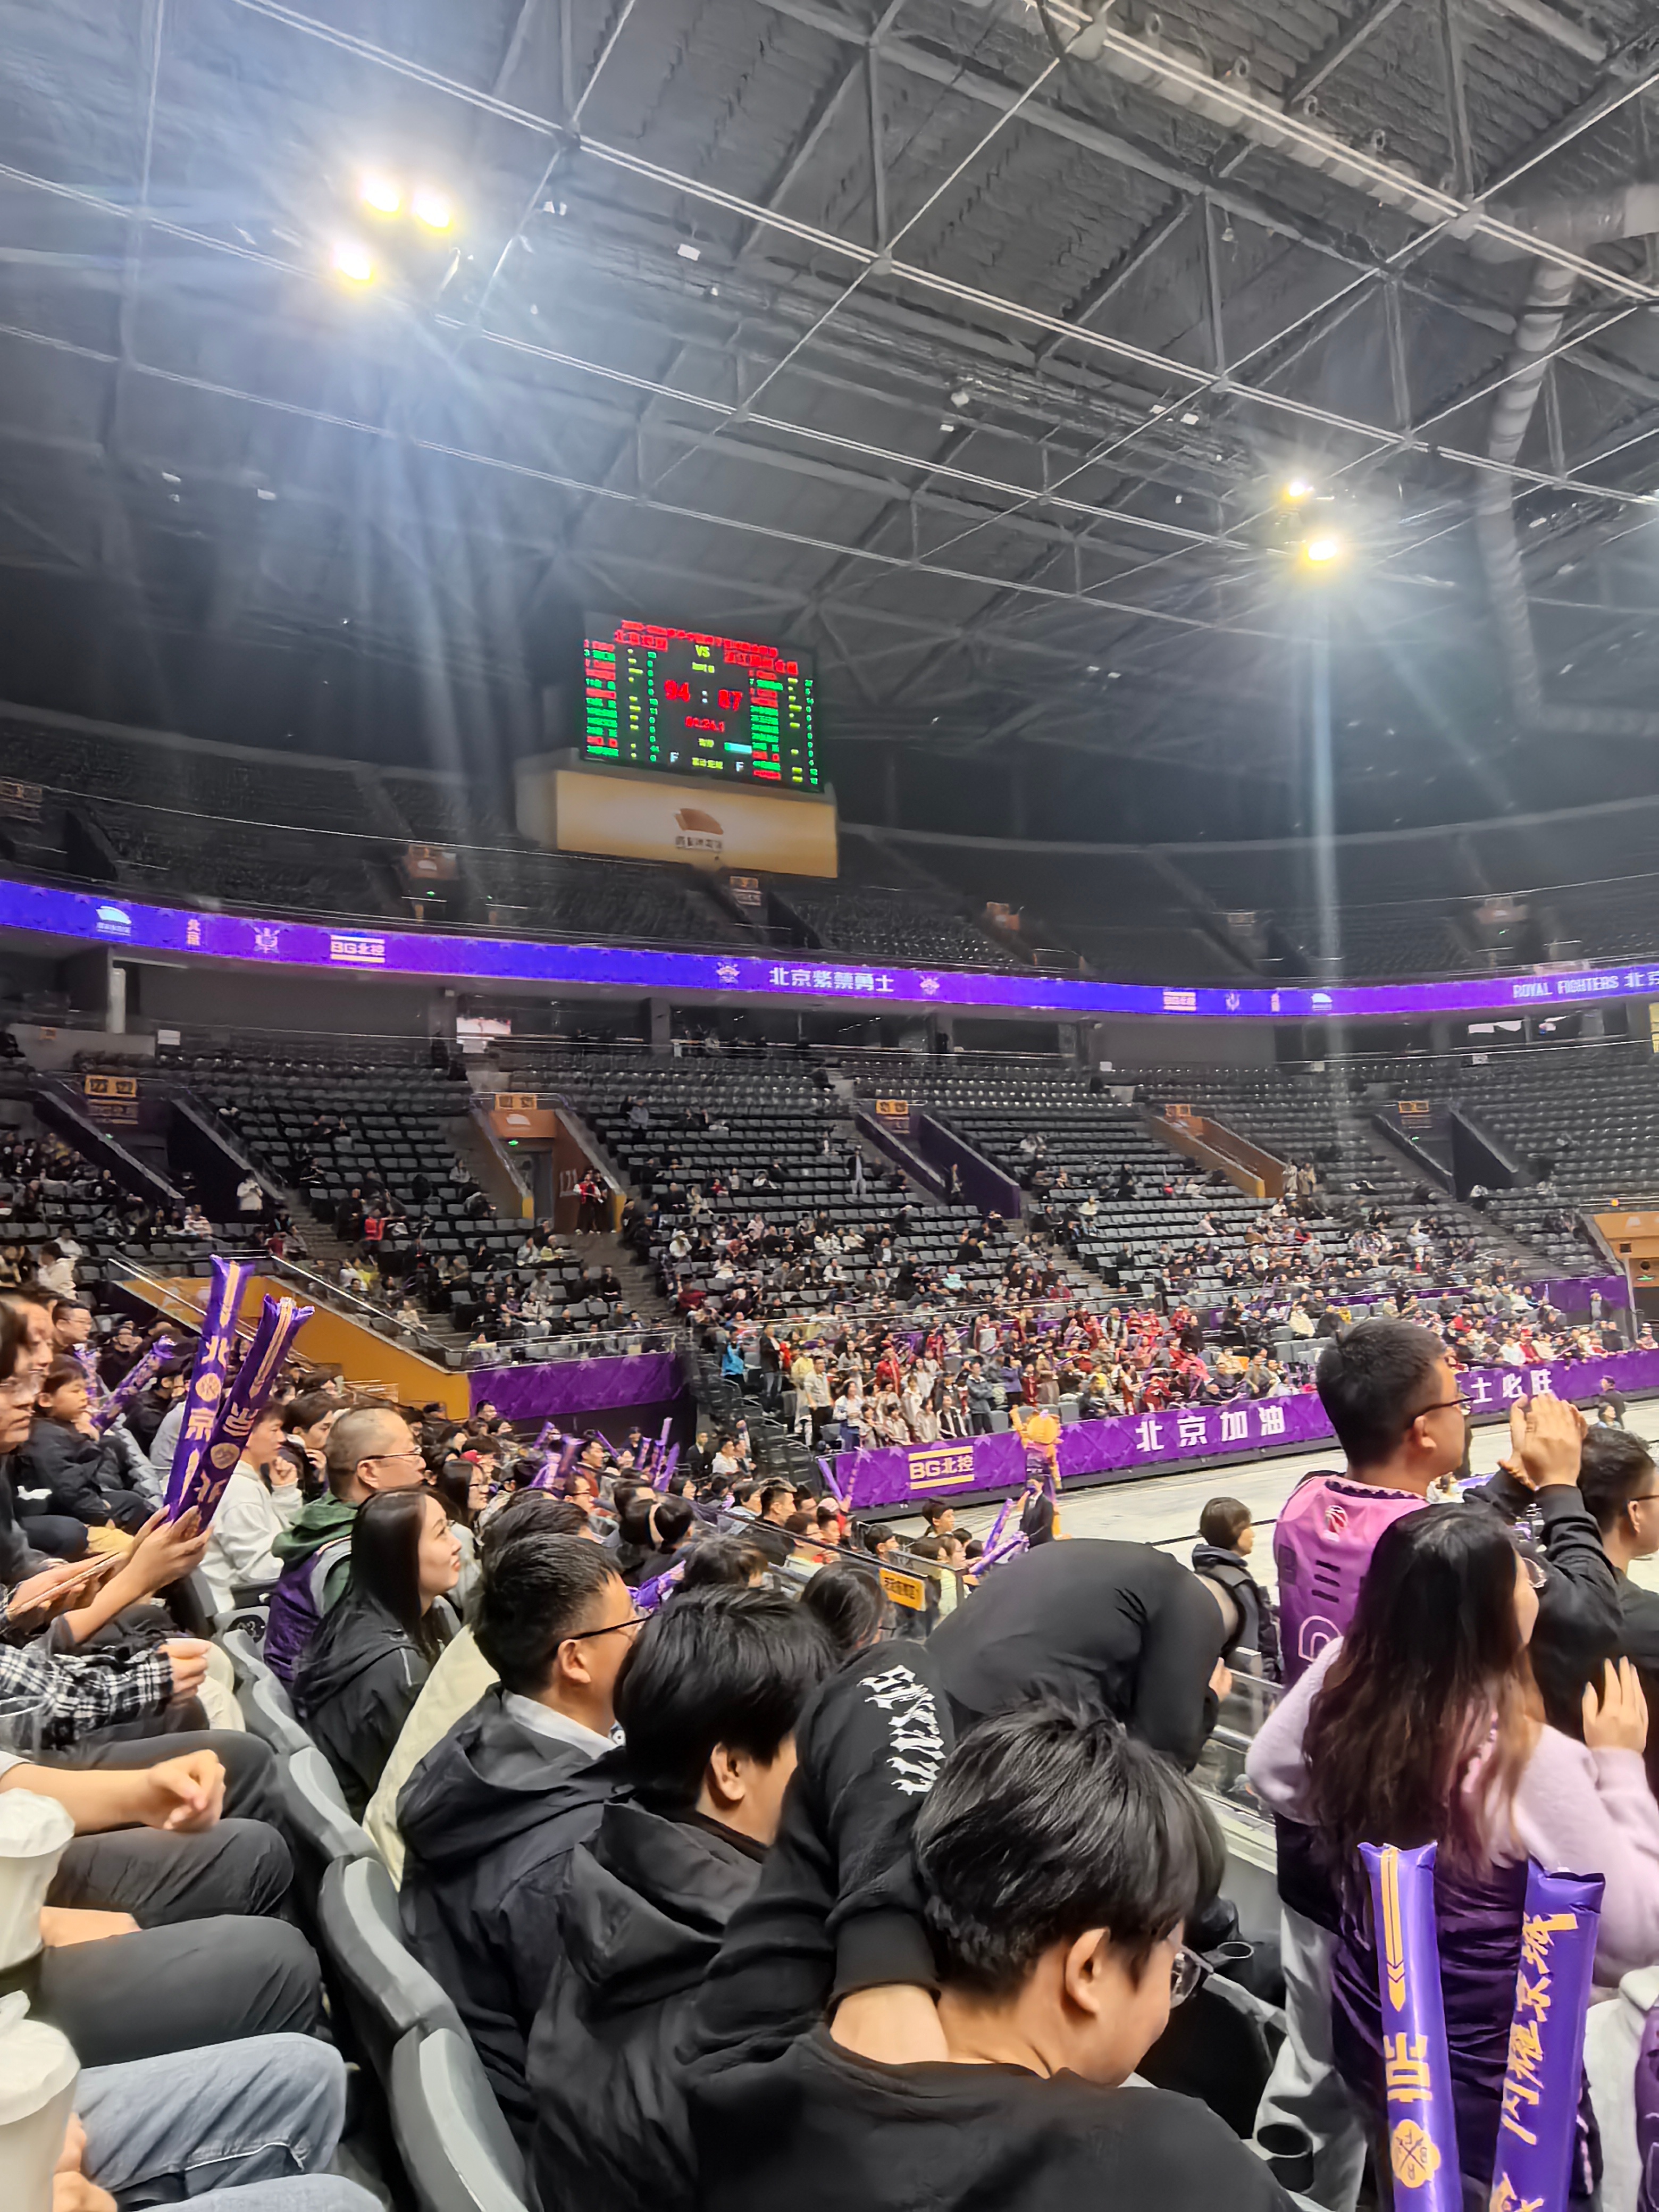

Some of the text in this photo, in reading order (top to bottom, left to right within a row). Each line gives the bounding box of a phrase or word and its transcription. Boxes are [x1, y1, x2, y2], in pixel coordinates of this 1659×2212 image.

[695, 644, 710, 658] VS
[664, 680, 691, 702] 94
[768, 967, 894, 993] 北京紫禁勇士
[1512, 982, 1553, 998] ROYAL
[1135, 1405, 1286, 1453] 北京加油
[909, 1454, 974, 1480] BG北控
